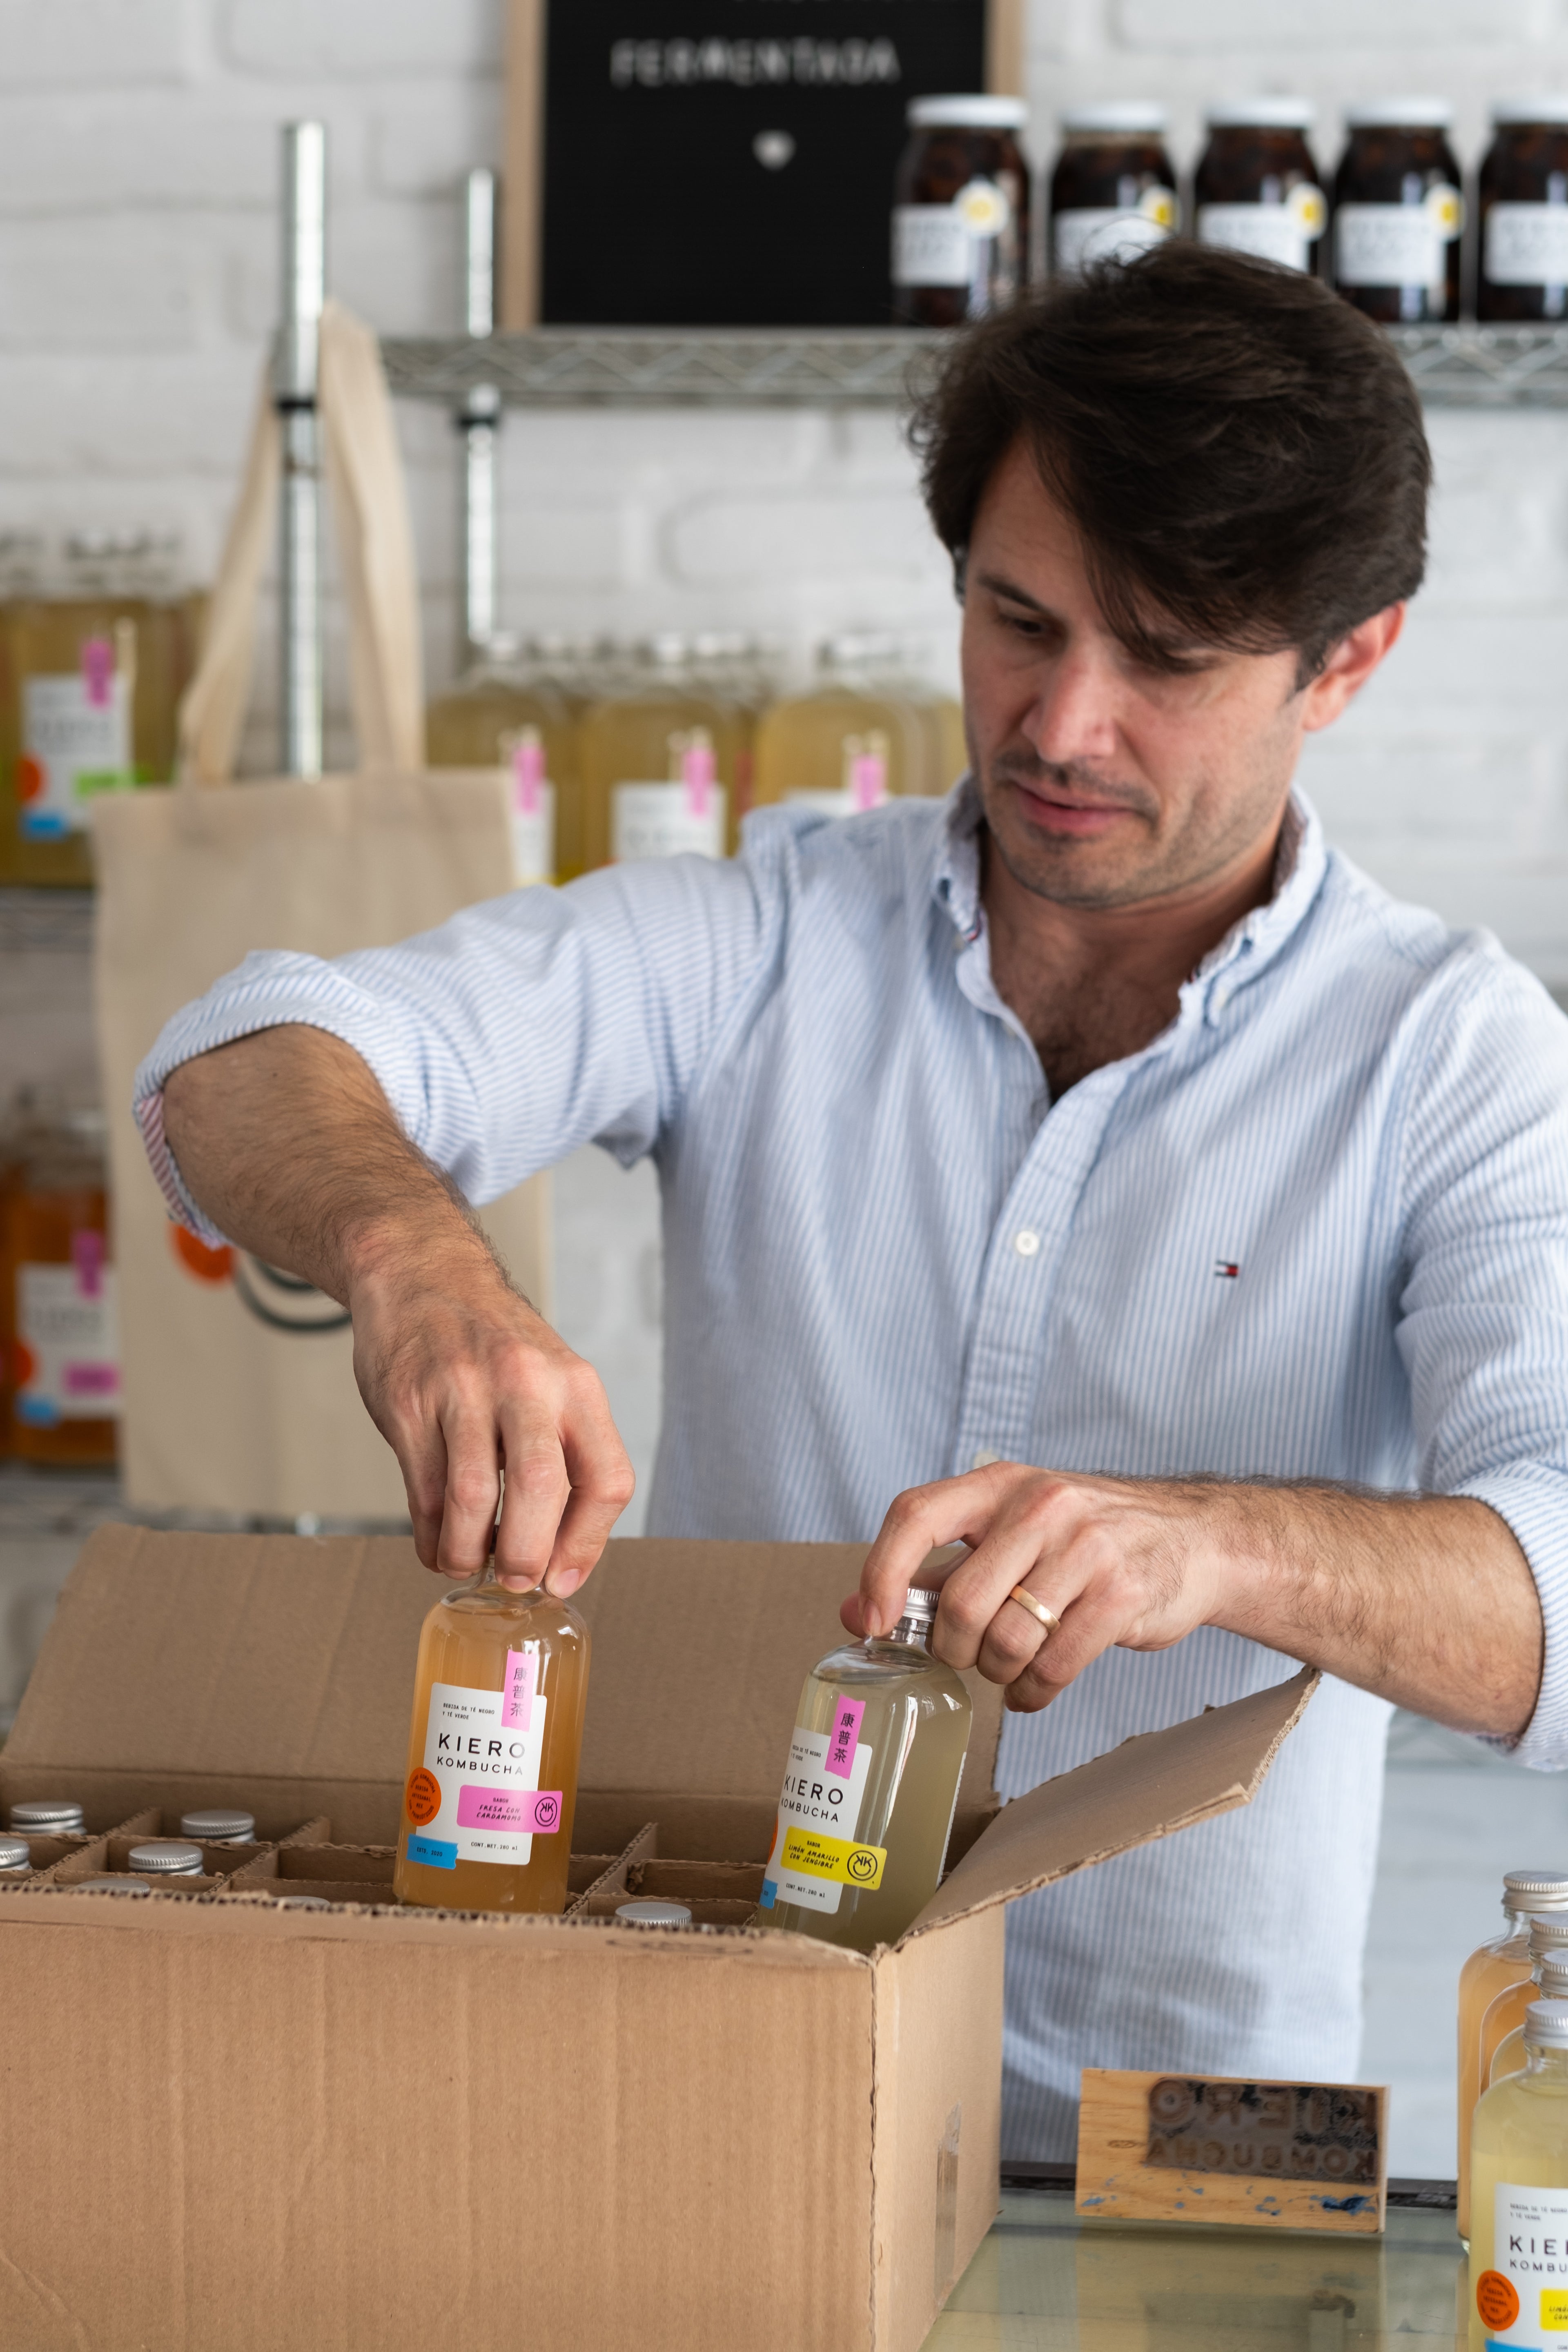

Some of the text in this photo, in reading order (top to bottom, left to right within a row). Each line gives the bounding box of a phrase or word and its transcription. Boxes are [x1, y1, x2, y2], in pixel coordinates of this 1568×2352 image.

[610, 36, 902, 87] FERMENTADA
[510, 1667, 528, 1717] 康普茶
[439, 1733, 525, 1758] KIERO
[833, 1713, 855, 1763] 康普茶
[437, 1756, 523, 1775] KOMBUCHA
[420, 1774, 436, 1793] KOMBUCHA
[784, 1774, 843, 1804] KIERO
[476, 1812, 521, 1821] CARDAMOMO
[479, 1804, 502, 1812] FRESA
[780, 1797, 838, 1822] KOMBUCHA
[788, 1844, 840, 1862] LIMÓN AMARILLO
[803, 1856, 834, 1869] JENGIBRE
[1510, 2234, 1568, 2255] KIE
